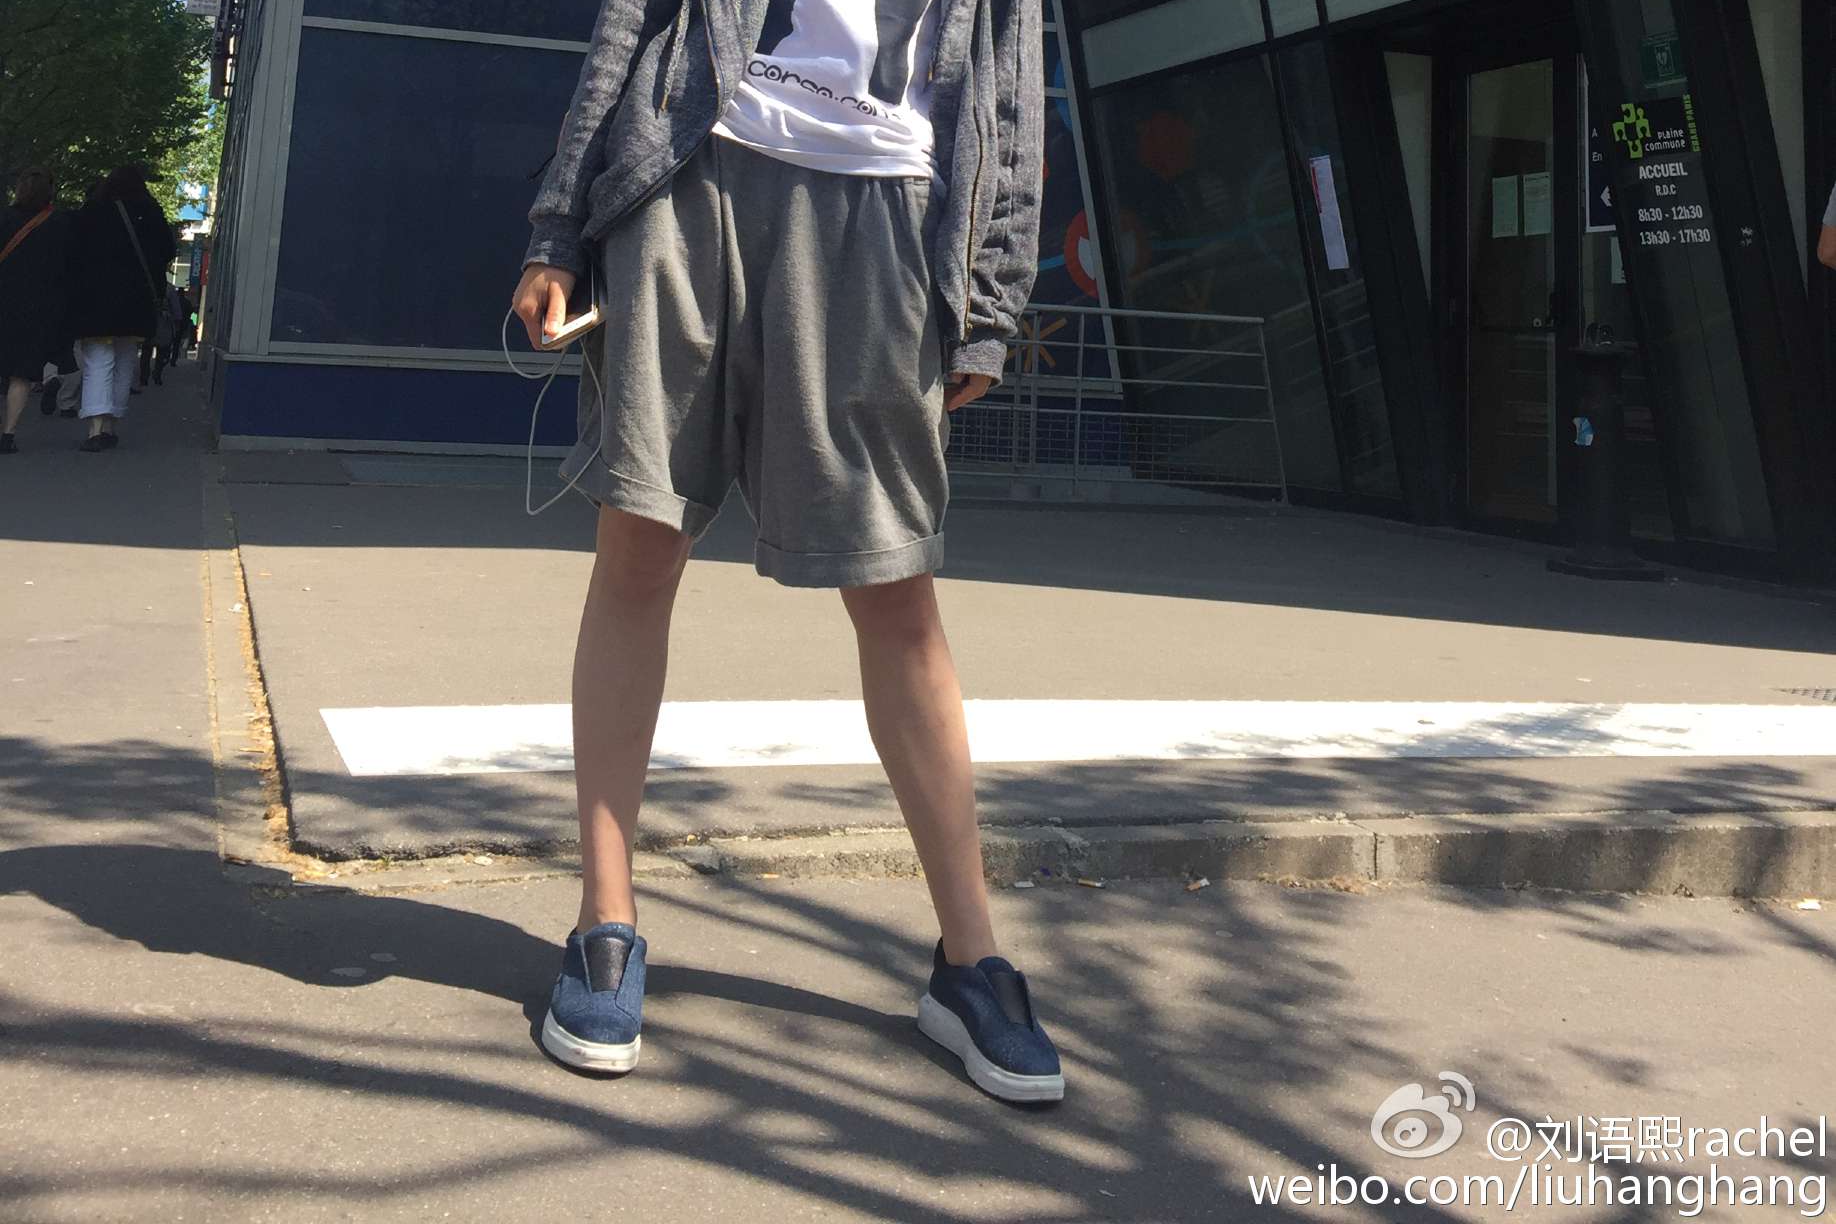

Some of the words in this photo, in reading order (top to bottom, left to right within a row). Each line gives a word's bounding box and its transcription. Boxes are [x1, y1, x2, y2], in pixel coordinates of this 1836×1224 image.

[1657, 128, 1684, 140] plaine
[1645, 139, 1686, 152] commune
[1639, 162, 1688, 180] ACCUEIL
[1655, 184, 1677, 196] R.D.C
[1638, 207, 1663, 222] 8h30
[1671, 205, 1703, 220] 12h30
[1640, 230, 1670, 245] 13h30
[1678, 228, 1711, 243] 17h30
